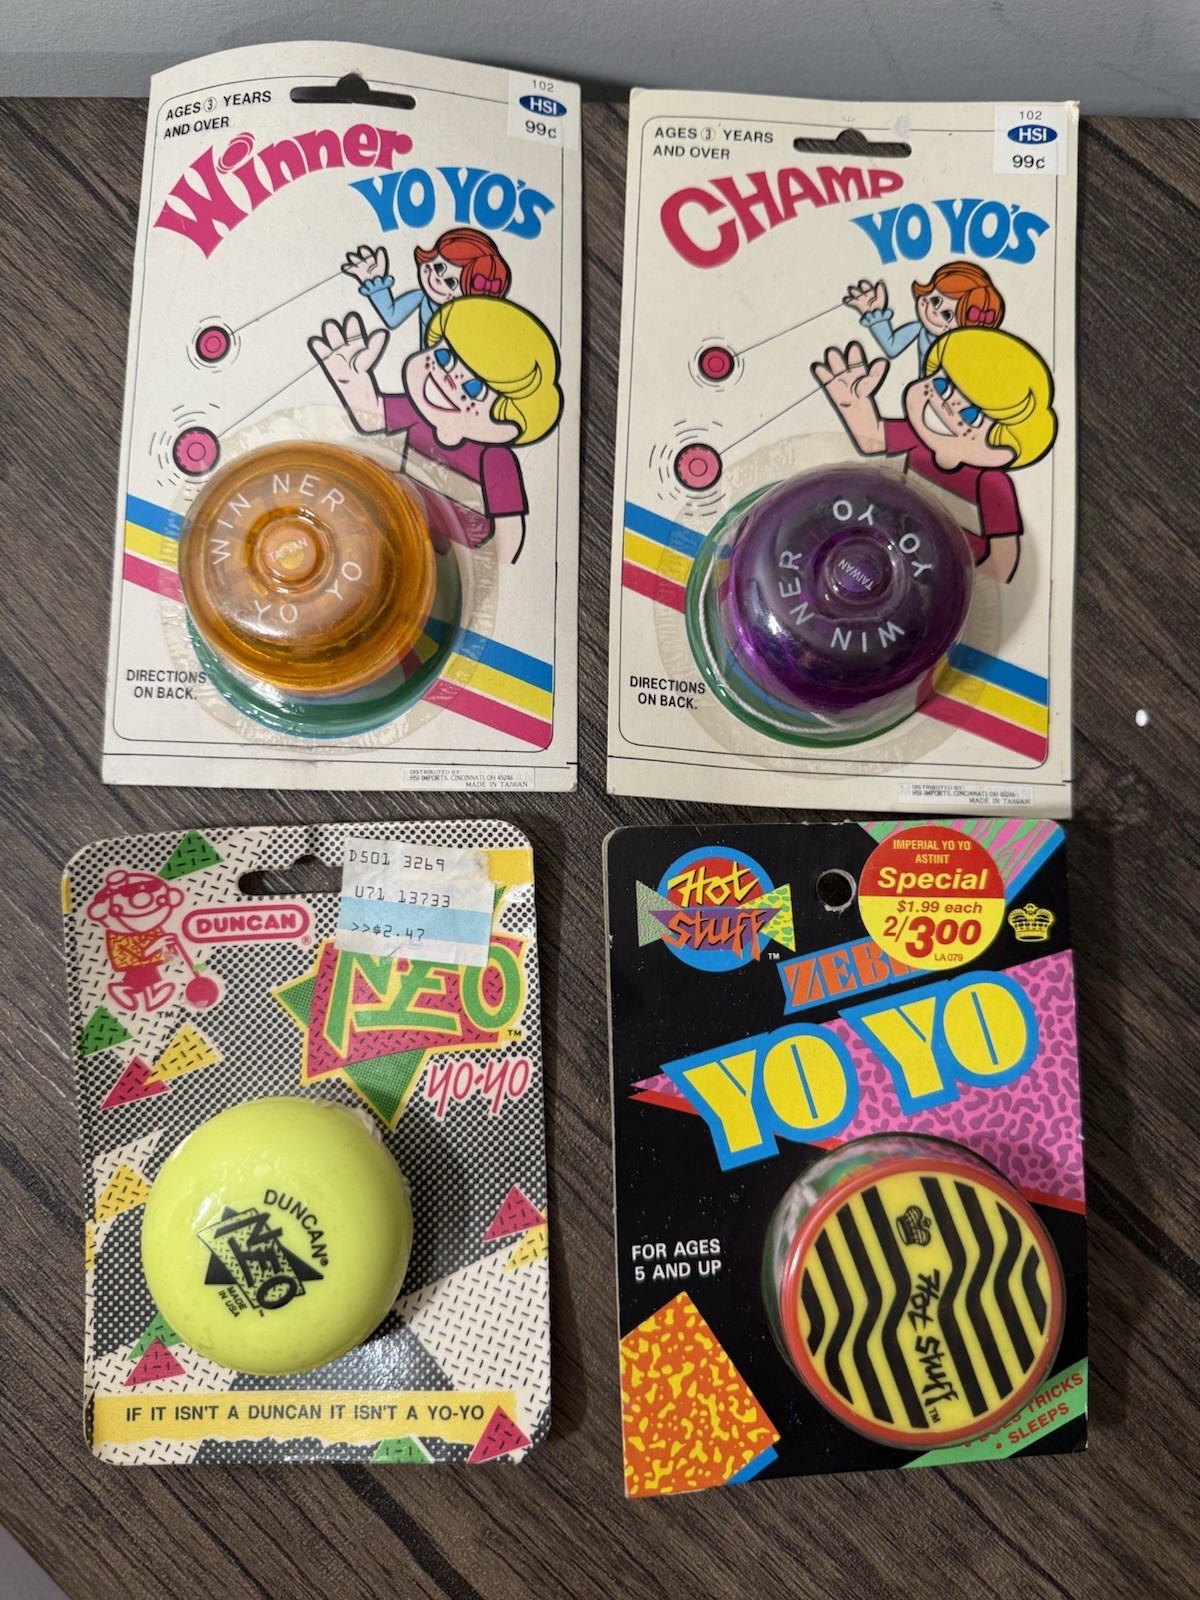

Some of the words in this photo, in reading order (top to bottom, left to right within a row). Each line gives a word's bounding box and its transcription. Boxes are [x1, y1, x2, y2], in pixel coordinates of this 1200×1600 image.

[532, 80, 554, 92] 102
[165, 101, 201, 121] AGES
[223, 90, 272, 107] YEARS
[529, 96, 558, 115] HSI
[1020, 110, 1042, 120] 102
[163, 122, 191, 139] AND
[193, 116, 230, 133] OVER
[654, 127, 697, 141] AGES
[723, 129, 774, 144] YEARS
[1018, 127, 1047, 142] HSI
[652, 146, 685, 159] AND
[690, 147, 730, 160] OVER
[153, 123, 414, 260] Winner
[348, 167, 436, 233] YO
[436, 166, 556, 240] YO'S
[660, 166, 904, 270] CHAMP
[849, 202, 932, 265] YO
[932, 198, 1051, 265] YO'S
[837, 558, 874, 591] TAIWAN
[126, 669, 207, 685] DIRECTIONS
[629, 676, 706, 695] DIRECTIONS
[134, 686, 155, 699] ON
[158, 685, 198, 700] BACK.
[638, 692, 657, 707] ON
[660, 693, 698, 710] BACK.
[893, 839, 939, 850] IMPERIAL
[942, 840, 955, 851] YO
[957, 841, 971, 851] YO
[403, 855, 445, 872] 3269
[915, 854, 950, 864] ASTINT
[666, 860, 760, 907] Hot
[877, 866, 988, 894] Special
[355, 885, 385, 901] U71
[398, 890, 451, 908] 13733
[897, 900, 939, 914] $1.99
[944, 902, 983, 914] each
[196, 913, 296, 934] DUNCAN
[661, 910, 767, 962] Stuff
[934, 953, 946, 961] LA
[324, 945, 522, 1049] NEO
[678, 1031, 849, 1156] YO
[857, 979, 1030, 1102] YO
[631, 1244, 670, 1260] FOR
[673, 1238, 721, 1257] AGES
[213, 1212, 298, 1310] NEO
[634, 1266, 646, 1281] 5
[652, 1263, 693, 1279] AND
[697, 1260, 722, 1276] UP
[218, 1290, 227, 1299] IN
[225, 1300, 241, 1318] USA
[226, 1286, 248, 1311] MADE
[907, 1268, 940, 1332] Hot
[915, 1335, 959, 1406] Stuff
[1025, 1372, 1084, 1413] TRICKS
[125, 1407, 142, 1422] IF
[150, 1407, 164, 1421] IT
[174, 1406, 220, 1421] ISN'T
[227, 1406, 240, 1420] A
[248, 1406, 322, 1421] DUNCAN
[330, 1405, 345, 1420] IT
[354, 1405, 399, 1420] ISN'T
[406, 1405, 418, 1420] A
[427, 1404, 484, 1421] YO-YO
[1008, 1402, 1070, 1444] SLEEPS
